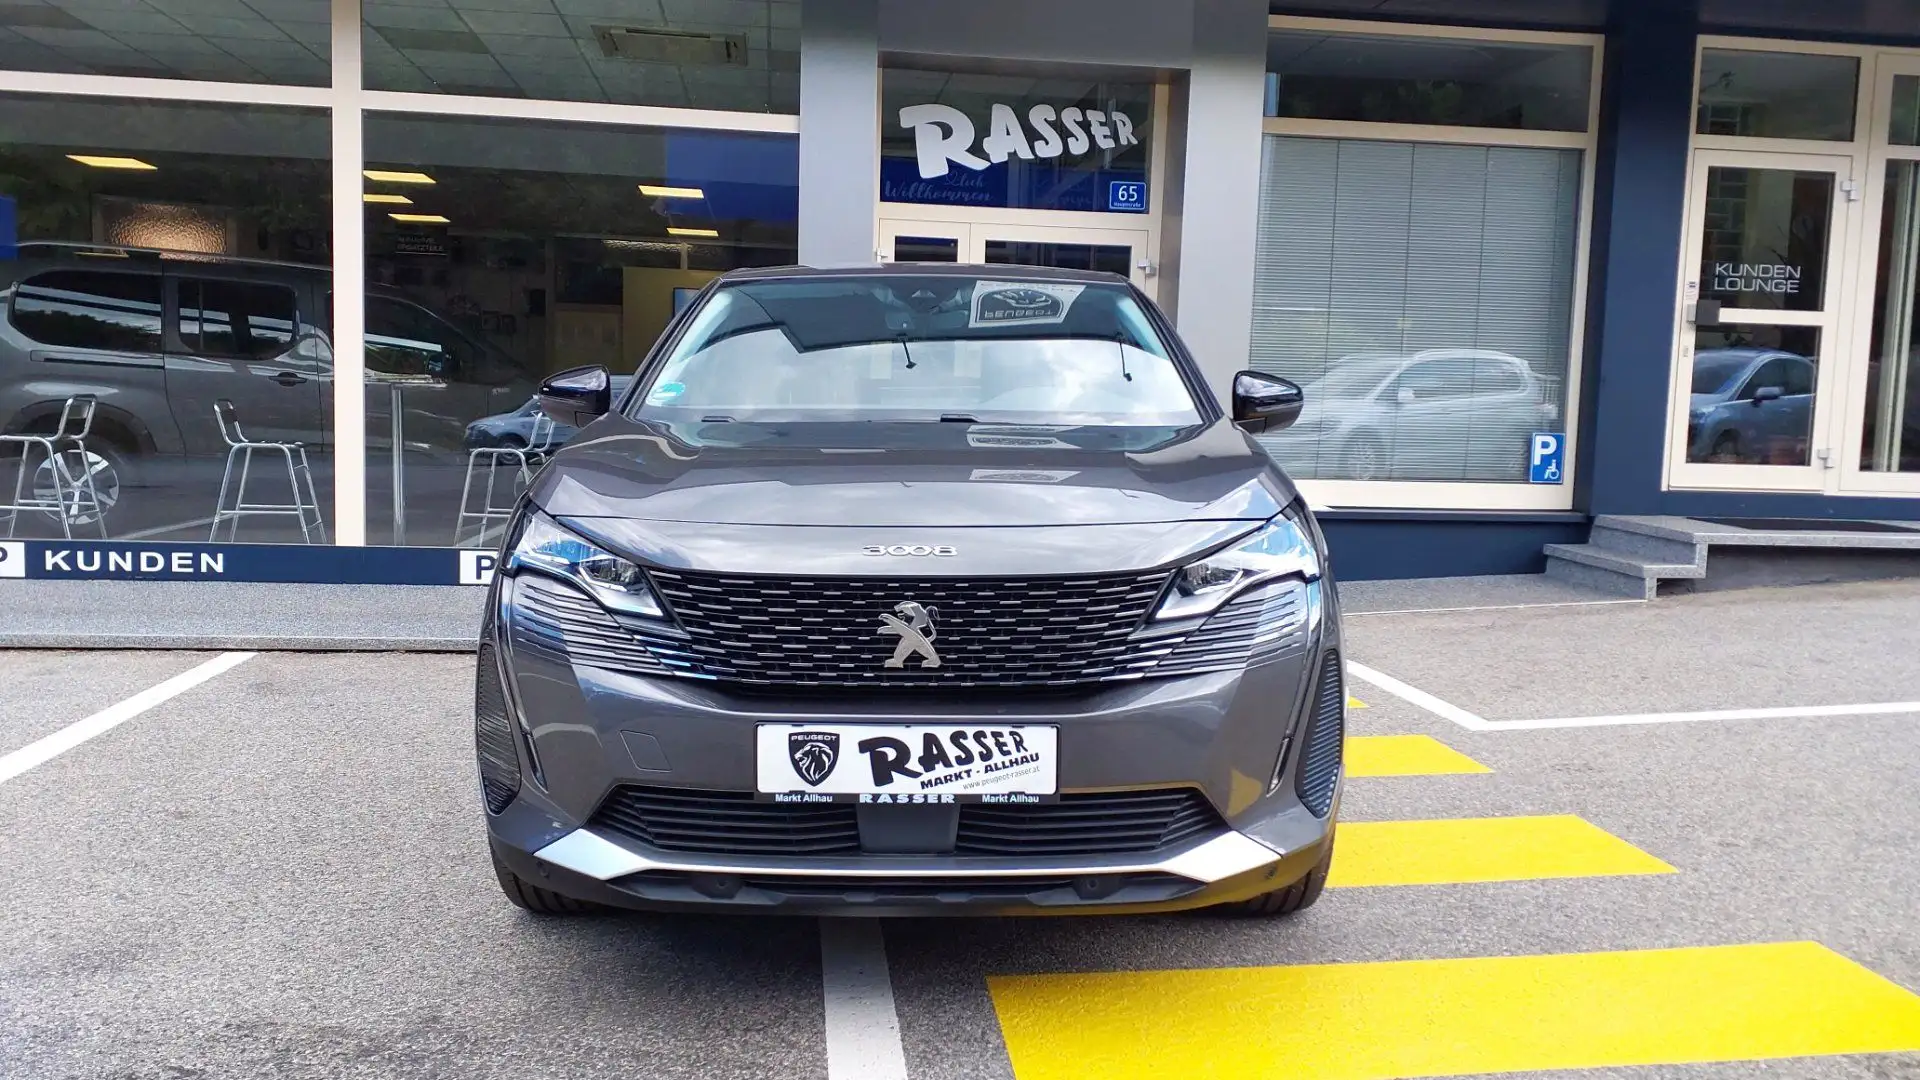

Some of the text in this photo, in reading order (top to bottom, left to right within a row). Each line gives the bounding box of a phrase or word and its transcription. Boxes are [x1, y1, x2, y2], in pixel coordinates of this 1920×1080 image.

[899, 103, 1138, 179] RASSER
[1118, 185, 1138, 201] 65
[1715, 262, 1801, 278] KUNDEN
[1714, 277, 1800, 293] LOUNGE
[1533, 435, 1557, 465] P
[862, 545, 958, 556] 3008
[45, 550, 224, 573] KUNDEN
[858, 730, 1028, 787] RASSER
[920, 769, 972, 790] MARKT
[984, 752, 1040, 774] ALLHAU
[962, 766, 1040, 790] www.peugeot-rasser.at
[775, 793, 833, 802] Markt Allhau
[860, 793, 955, 804] RASSER
[982, 794, 1039, 803] Markt Allhau
